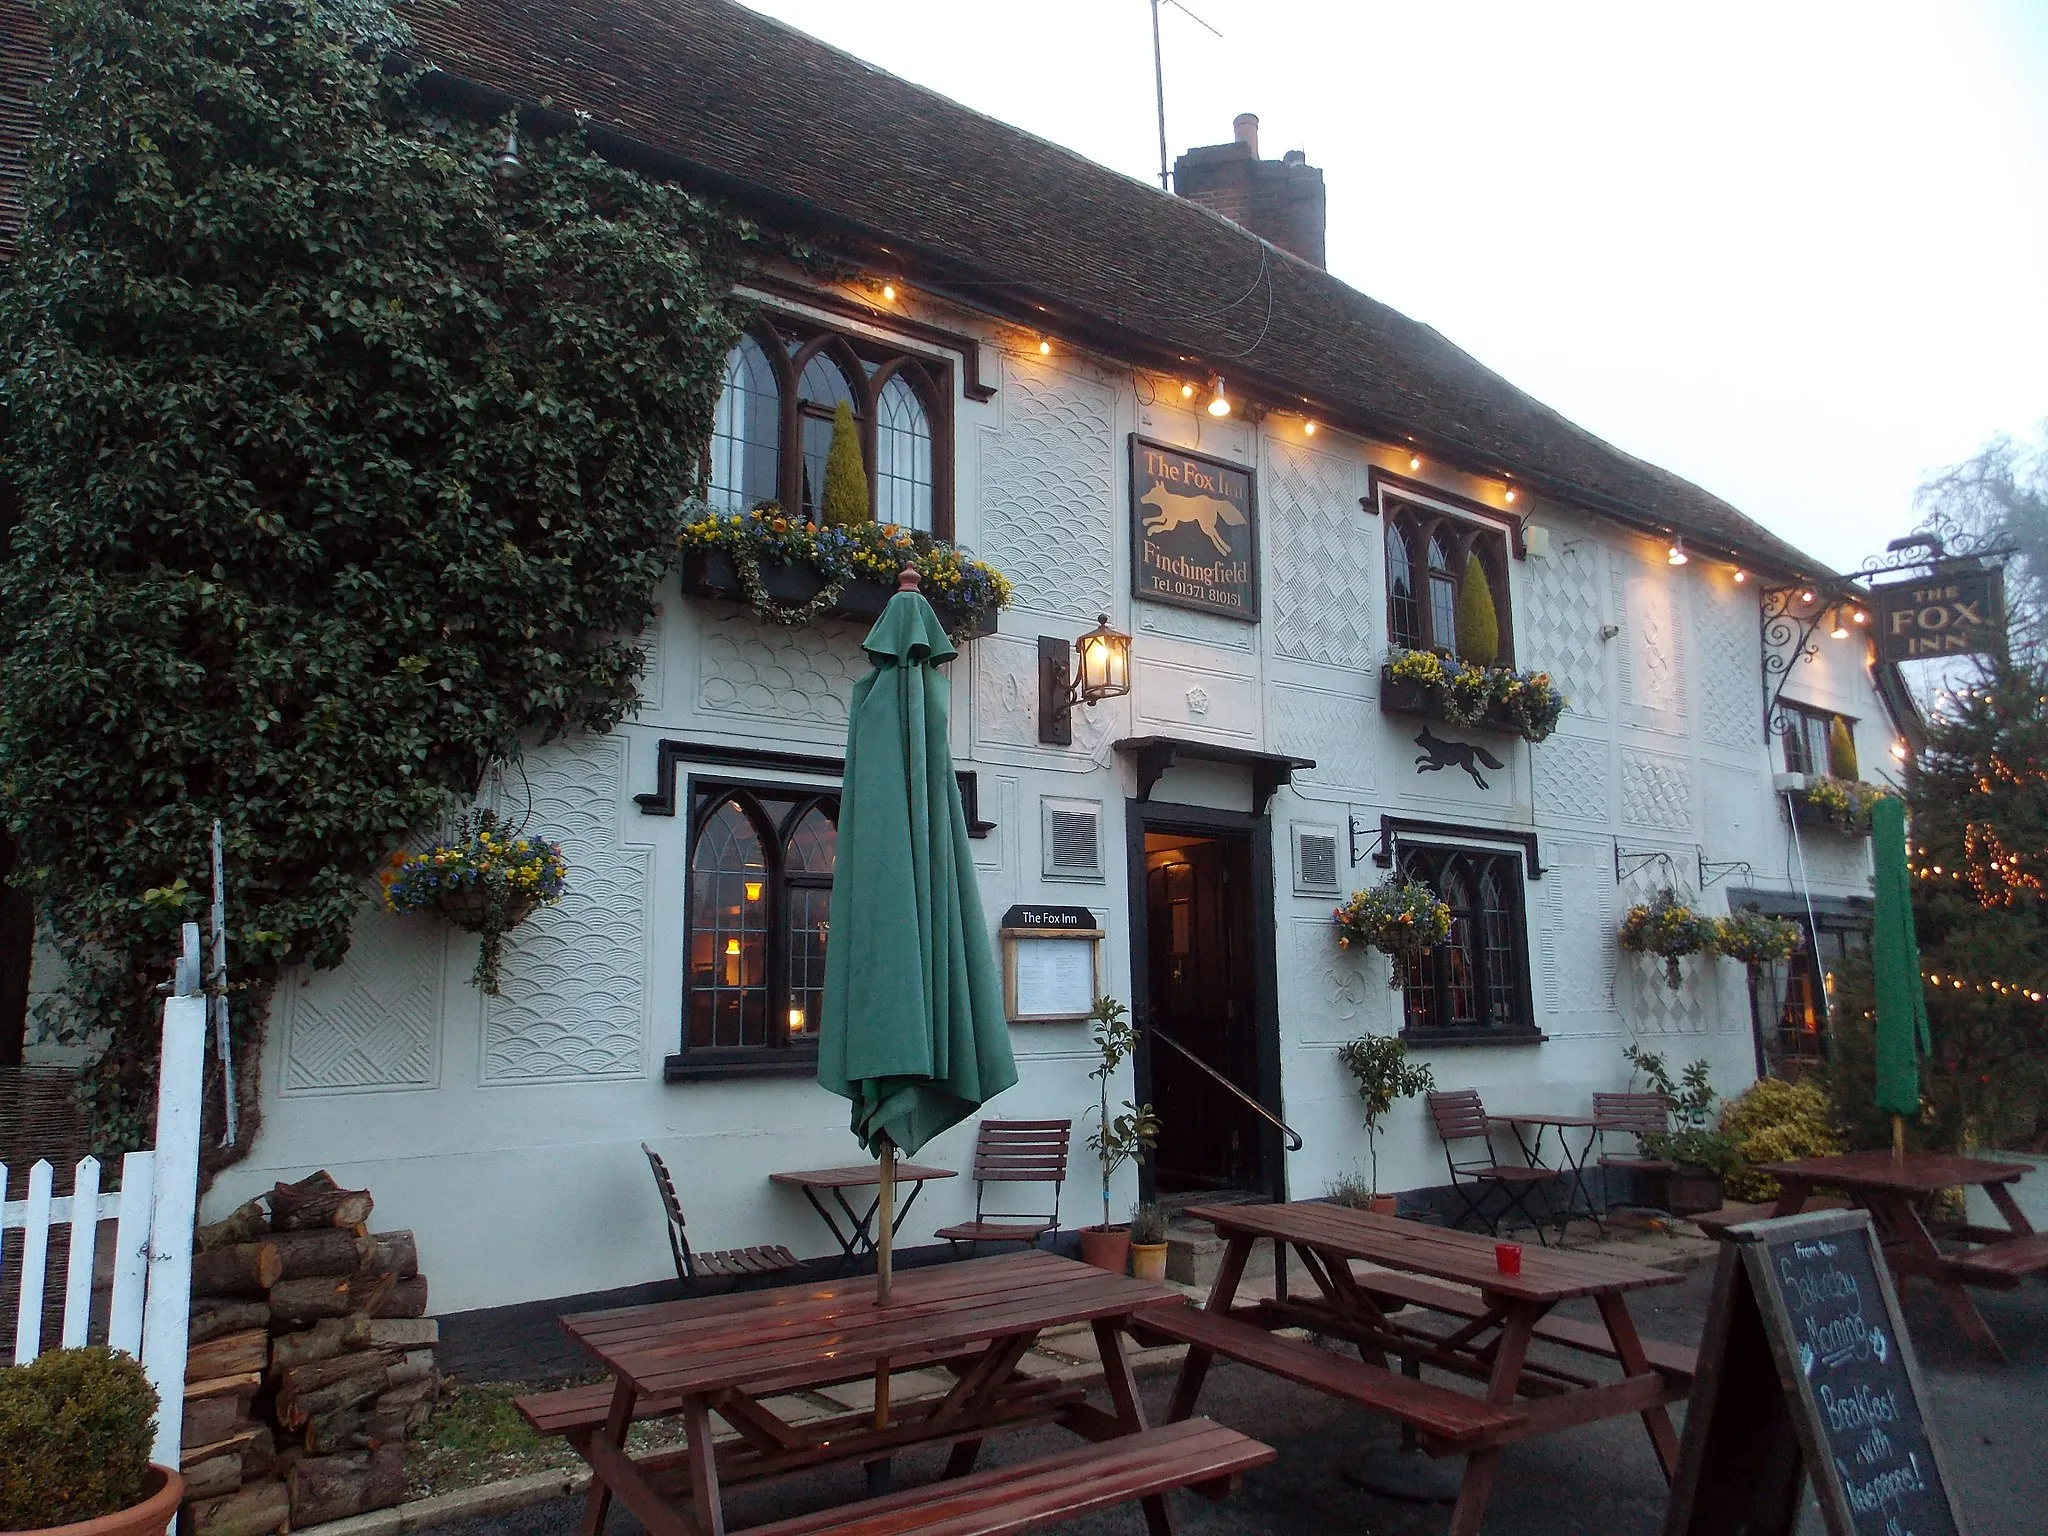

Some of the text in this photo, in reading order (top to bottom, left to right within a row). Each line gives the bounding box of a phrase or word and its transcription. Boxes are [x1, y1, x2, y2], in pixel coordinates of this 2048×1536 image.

[1143, 451, 1179, 481] The
[1183, 461, 1215, 493] Fox
[1143, 540, 1247, 585] Finchingfield
[1152, 576, 1241, 607] Tel. 01371 810151
[1912, 585, 1960, 602] THE
[1891, 600, 1982, 635] FOX
[1908, 633, 1969, 655] INN
[1023, 912, 1077, 924] The Fox Inn
[1794, 1241, 1819, 1259] From
[1780, 1257, 1862, 1318] Saturday
[1804, 1315, 1870, 1361] Morning
[1820, 1385, 1900, 1432] Breakfast
[1858, 1428, 1892, 1464] with
